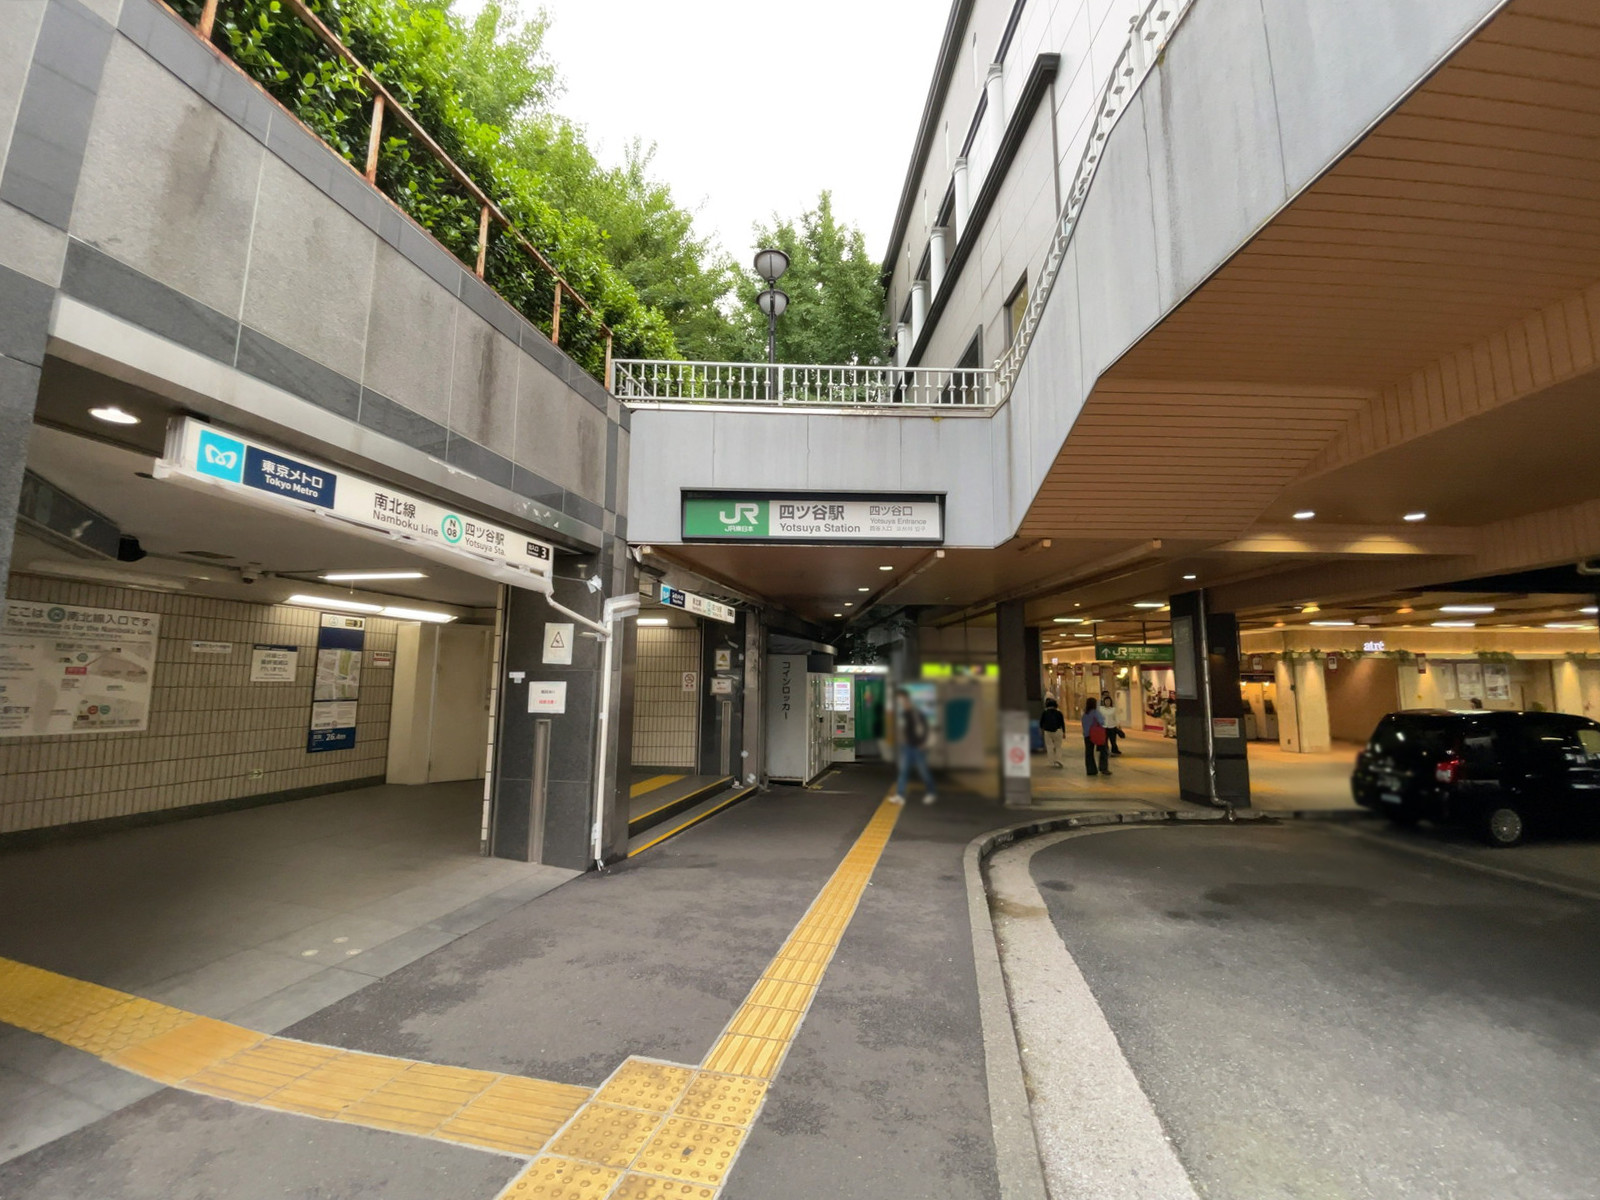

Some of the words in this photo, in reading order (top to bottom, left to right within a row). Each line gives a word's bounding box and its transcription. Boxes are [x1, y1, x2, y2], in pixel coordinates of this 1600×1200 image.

[261, 459, 324, 489] 東京メトロ
[265, 474, 291, 491] Tokyo
[292, 483, 319, 498] Metro
[373, 493, 416, 519] 南北線
[719, 503, 759, 524] JR
[779, 504, 845, 521] 四ツ谷駅
[869, 505, 913, 517] 四ツ谷口
[372, 509, 418, 531] Namboku
[420, 525, 440, 537] Line
[449, 519, 457, 528] N
[724, 525, 754, 533] JR東日本
[779, 523, 821, 534] Yotsuya
[823, 523, 861, 533] Station
[869, 517, 896, 525] Yotsuya
[446, 527, 458, 538] 08
[465, 522, 505, 546] 四ツ谷駅
[465, 536, 493, 554] Yotsuya
[493, 545, 506, 556] Sta.
[540, 547, 547, 559] 3
[1112, 646, 1128, 656] JR
[781, 661, 791, 720] コインロッカー
